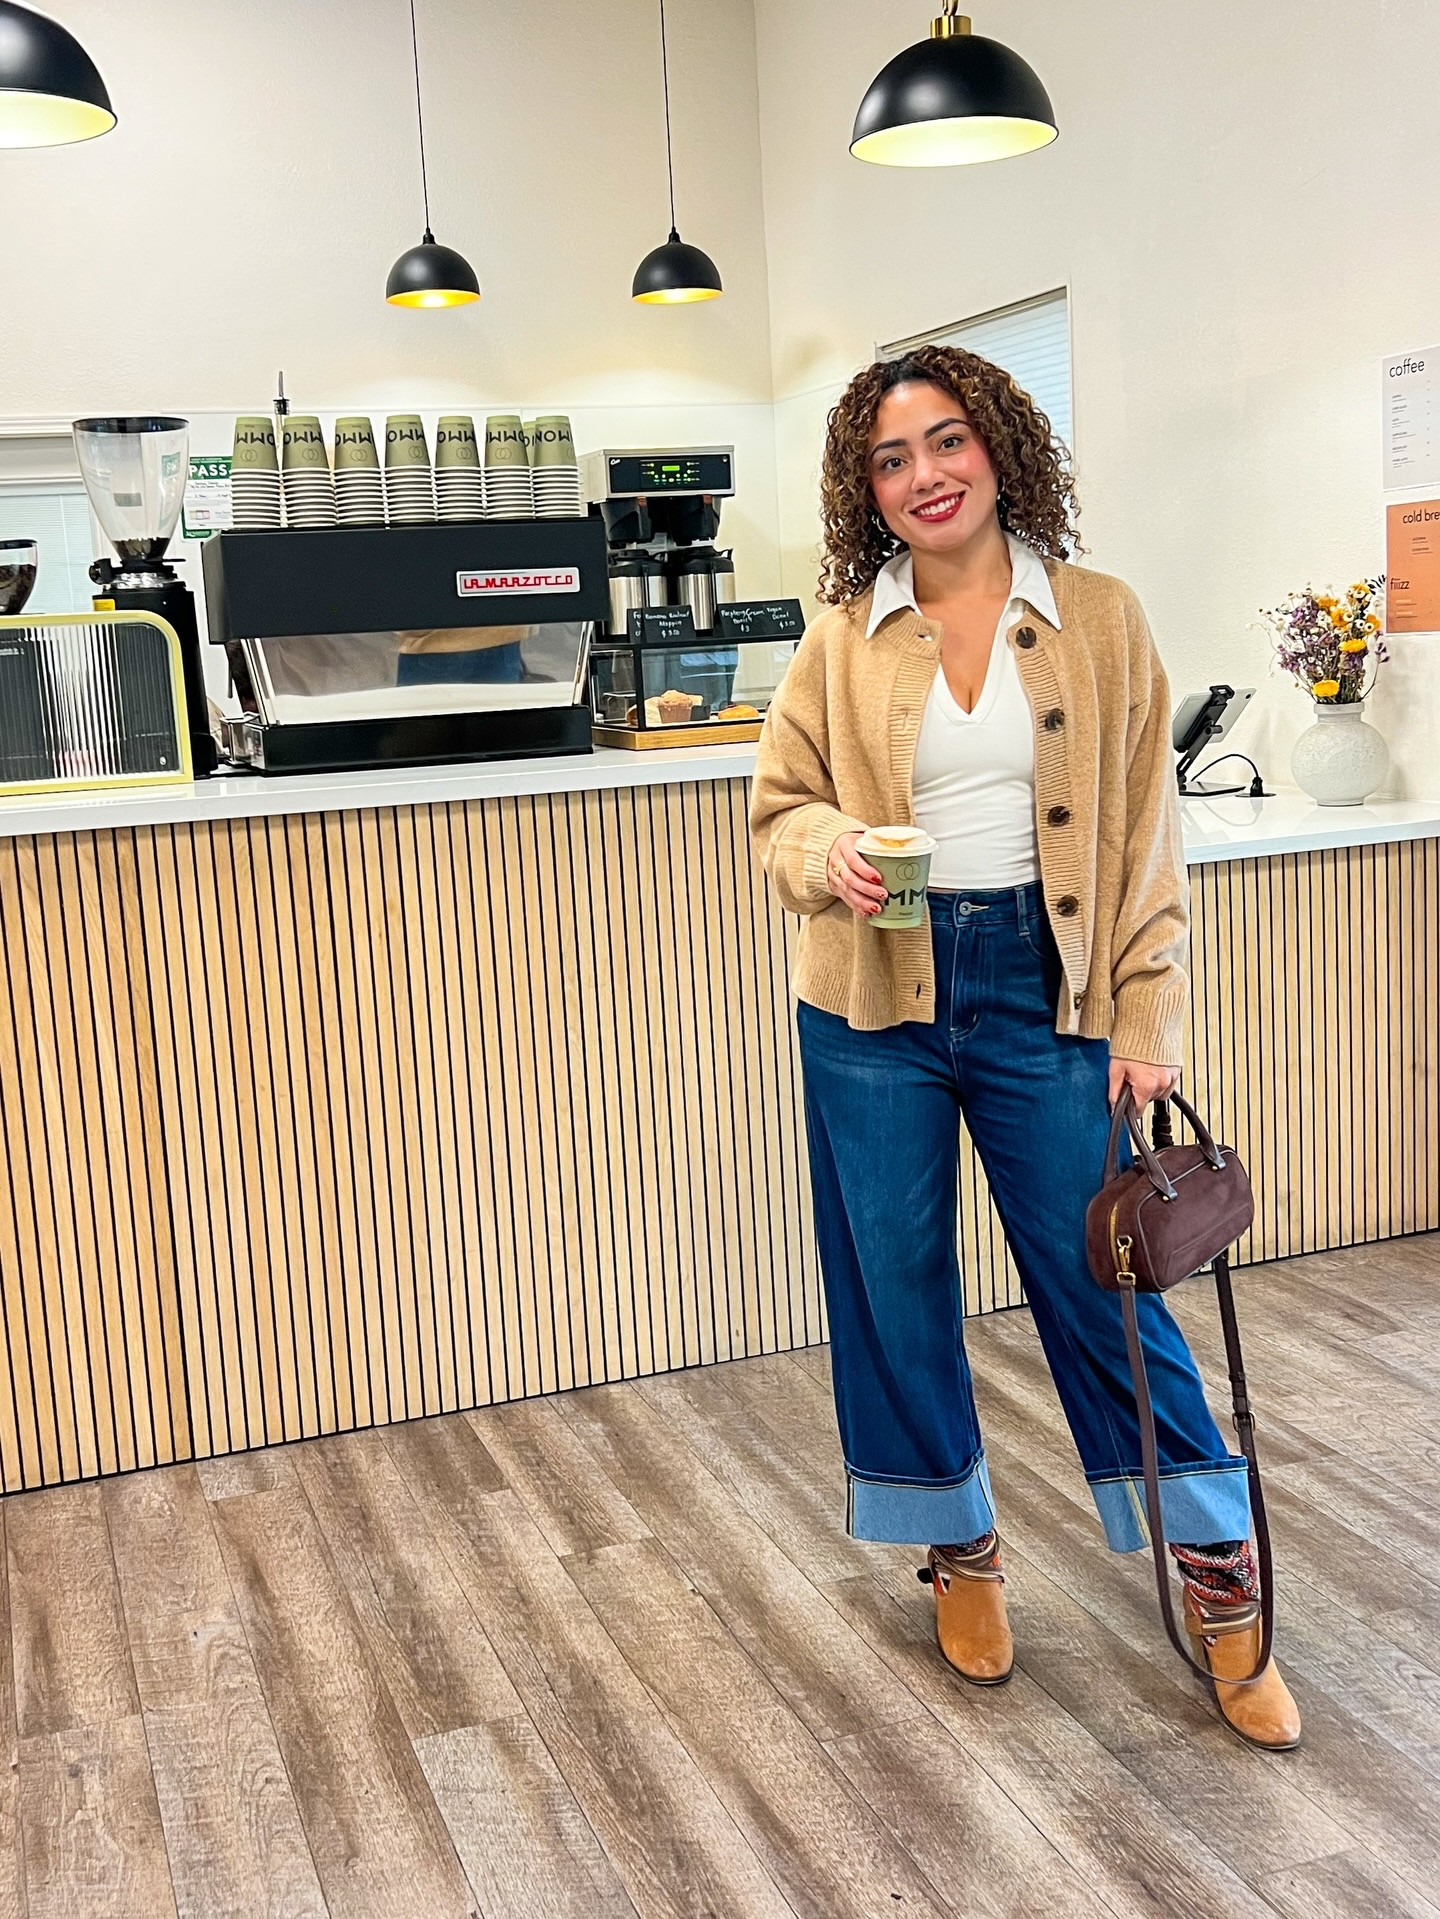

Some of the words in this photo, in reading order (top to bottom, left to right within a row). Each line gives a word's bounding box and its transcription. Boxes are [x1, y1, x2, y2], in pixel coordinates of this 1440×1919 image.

[1389, 358, 1425, 378] coffee
[188, 463, 228, 478] PASS
[1402, 509, 1422, 524] cold
[1424, 508, 1440, 522] bre
